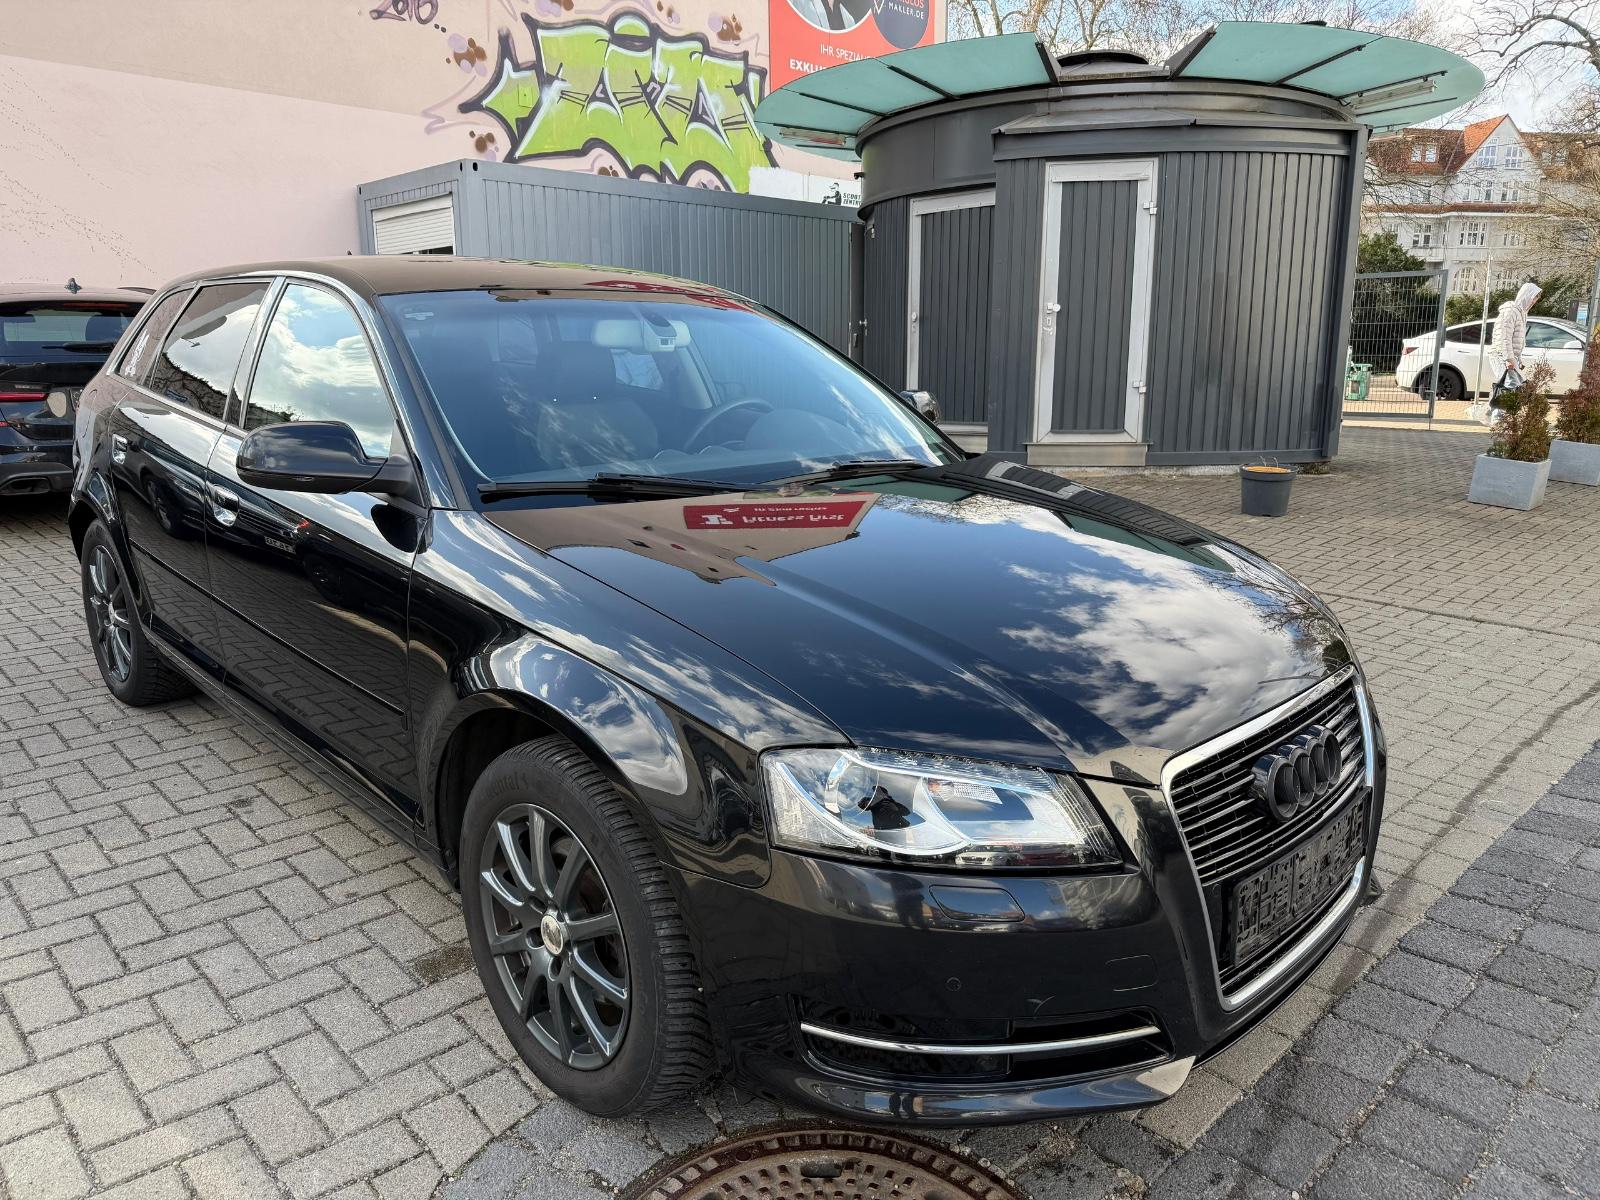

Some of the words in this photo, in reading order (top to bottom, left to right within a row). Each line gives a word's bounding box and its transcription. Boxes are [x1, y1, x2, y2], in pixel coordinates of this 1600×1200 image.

[888, 2, 924, 20] MAKLER.DE
[820, 43, 834, 57] IHR
[789, 58, 827, 74] EXKL
